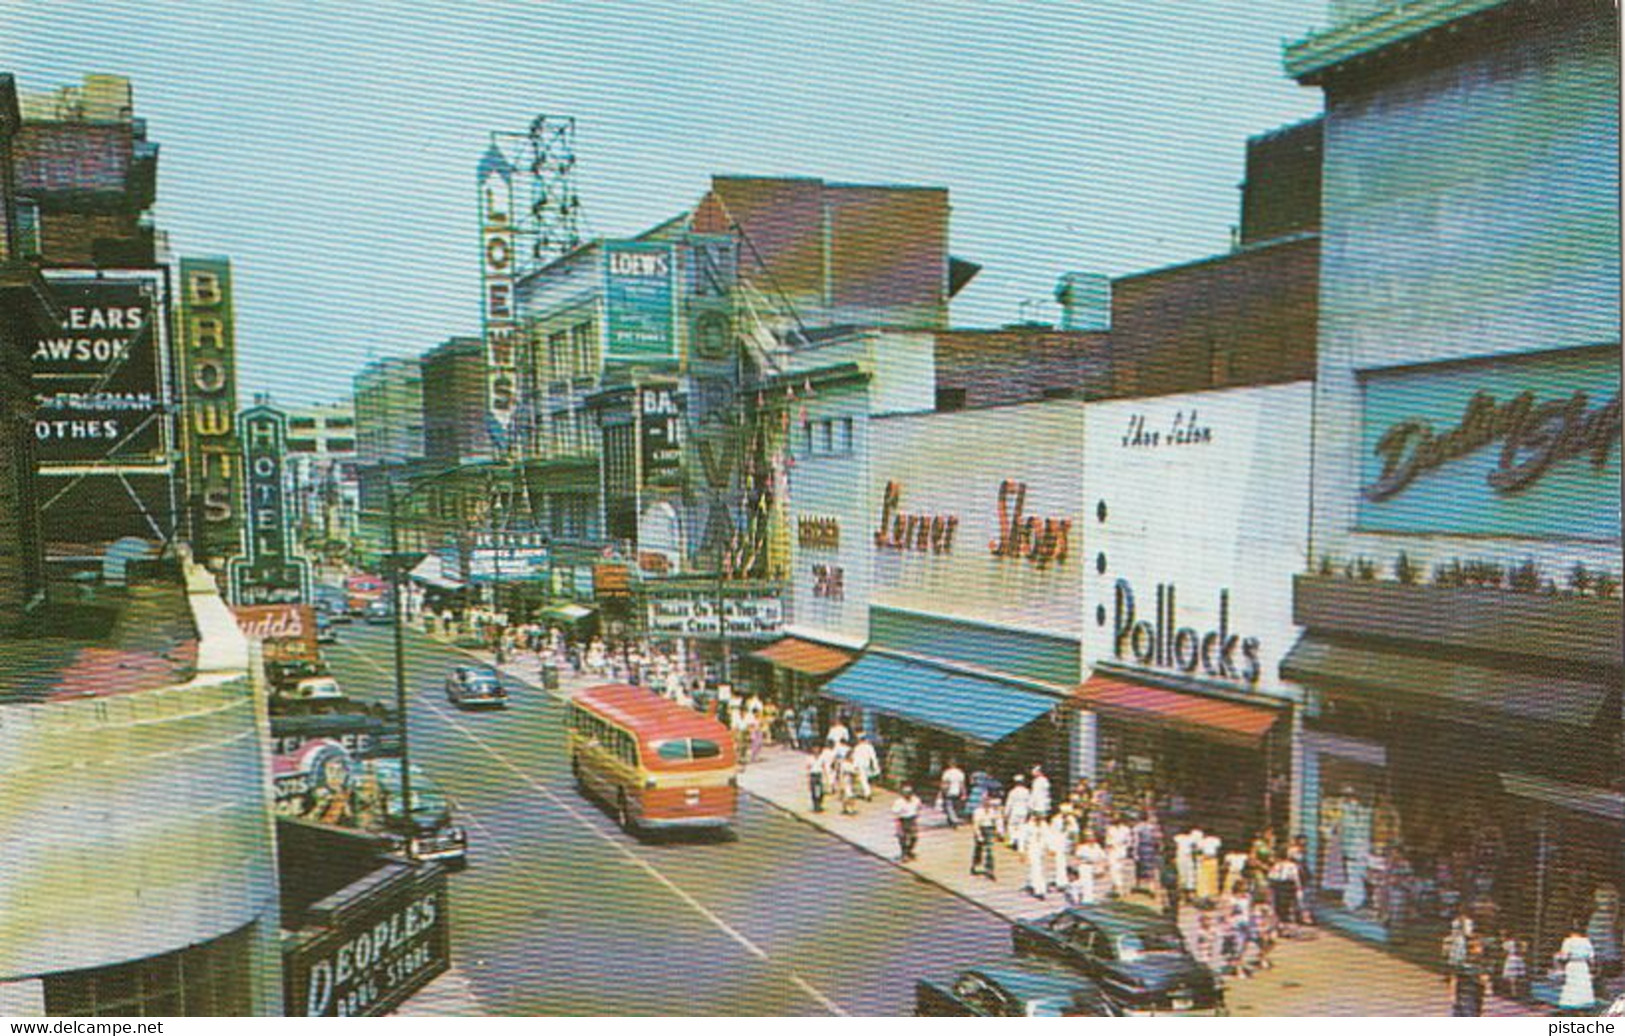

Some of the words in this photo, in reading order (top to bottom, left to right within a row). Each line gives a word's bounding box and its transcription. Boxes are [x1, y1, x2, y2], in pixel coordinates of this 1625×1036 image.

[62, 307, 142, 329] EARS
[31, 339, 129, 360] AWSON
[35, 420, 118, 439] OTHES
[250, 420, 276, 556] HOTEL
[1113, 577, 1261, 687] Pollocks
